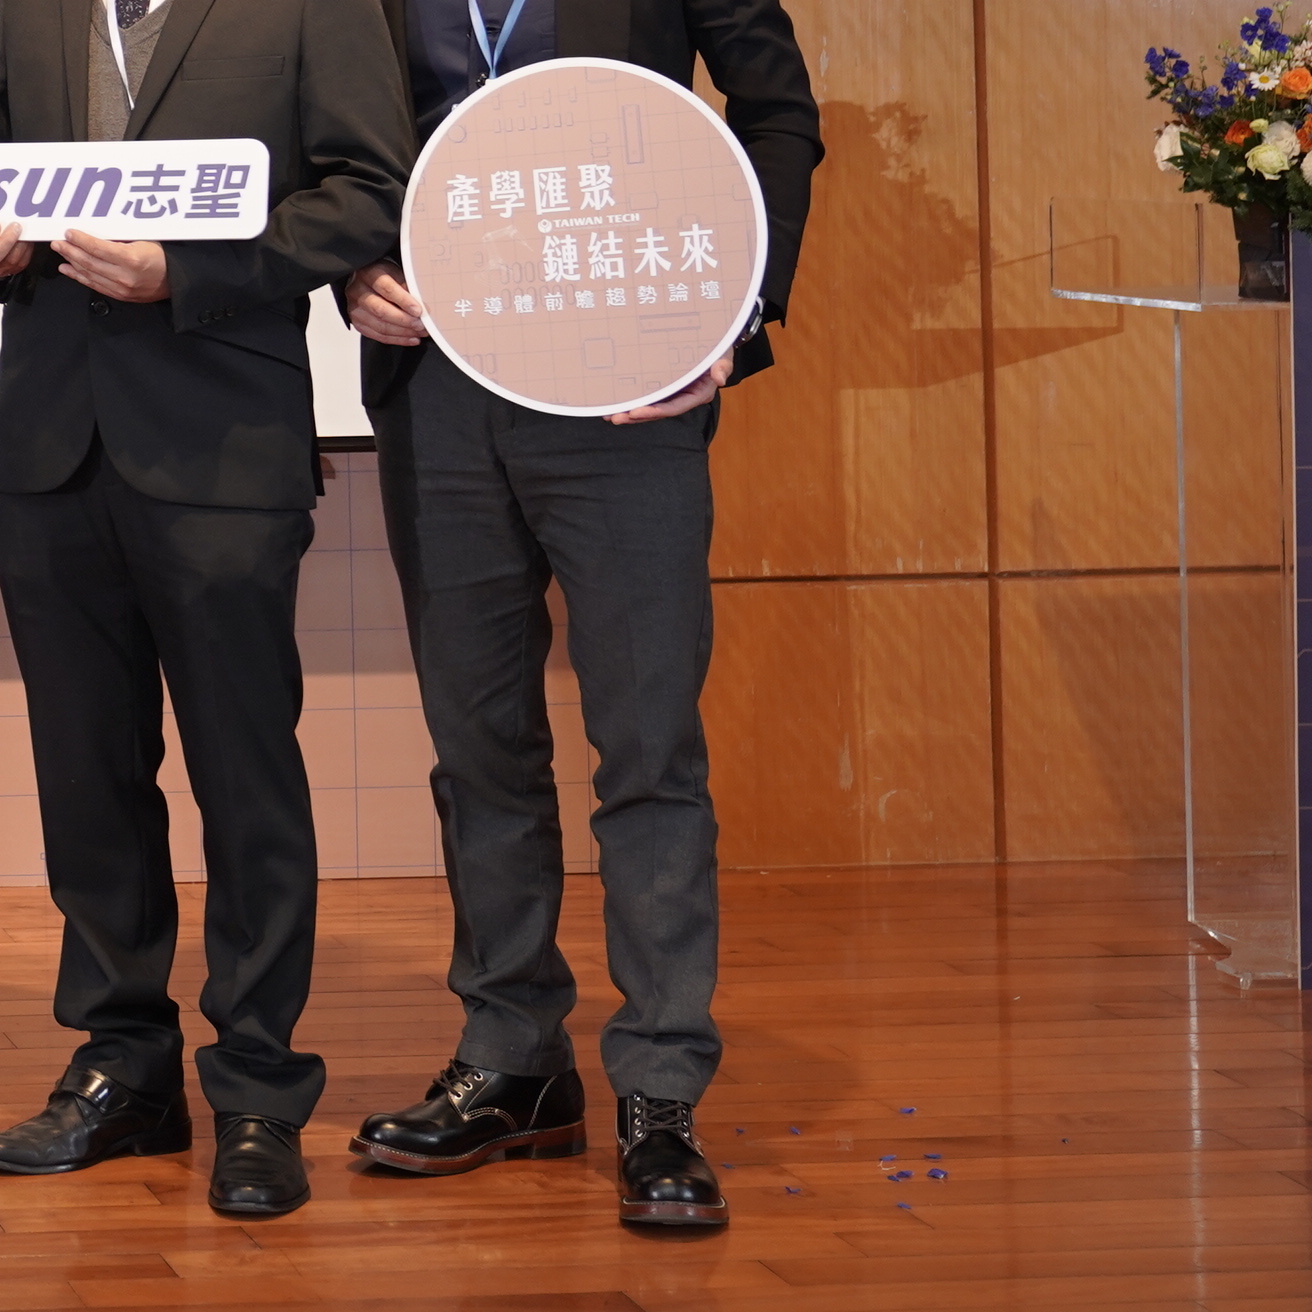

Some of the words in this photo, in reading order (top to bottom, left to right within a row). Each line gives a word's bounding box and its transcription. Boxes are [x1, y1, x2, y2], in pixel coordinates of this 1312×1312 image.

[121, 163, 251, 219] 志聖
[446, 163, 616, 223] 產學匯聚
[553, 216, 603, 228] TAIWAN
[606, 212, 640, 224] TECH
[541, 223, 718, 283] 鏈結未來
